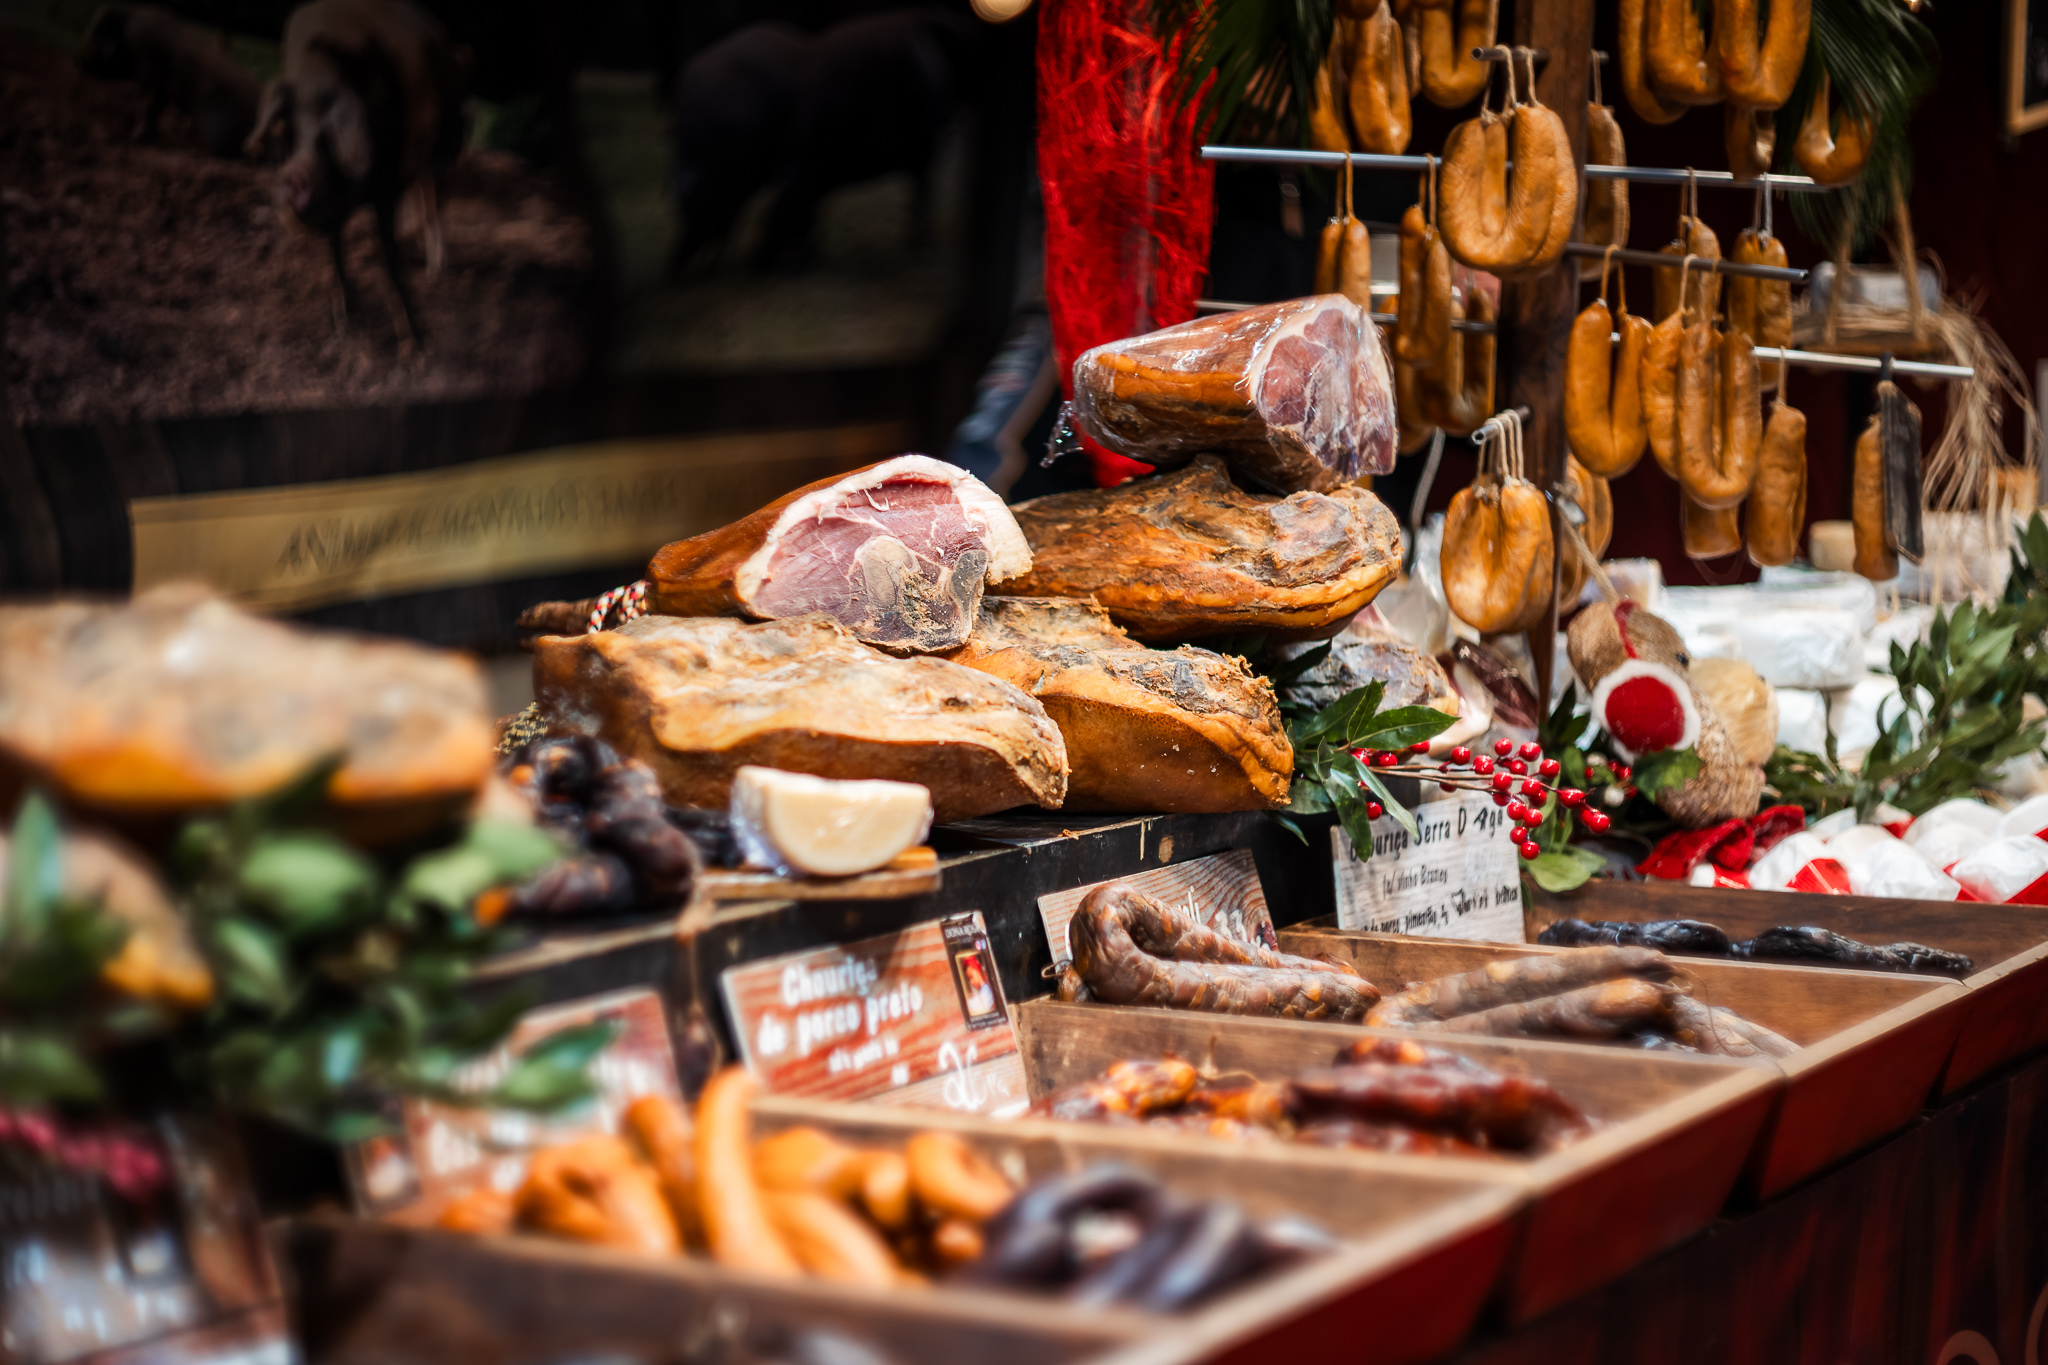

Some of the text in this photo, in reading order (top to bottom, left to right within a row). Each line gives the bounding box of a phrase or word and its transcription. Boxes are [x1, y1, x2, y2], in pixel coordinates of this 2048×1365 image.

[1415, 813, 1450, 846] Serra
[1458, 807, 1467, 836] D
[797, 1002, 861, 1058] porco
[865, 981, 923, 1036] preto
